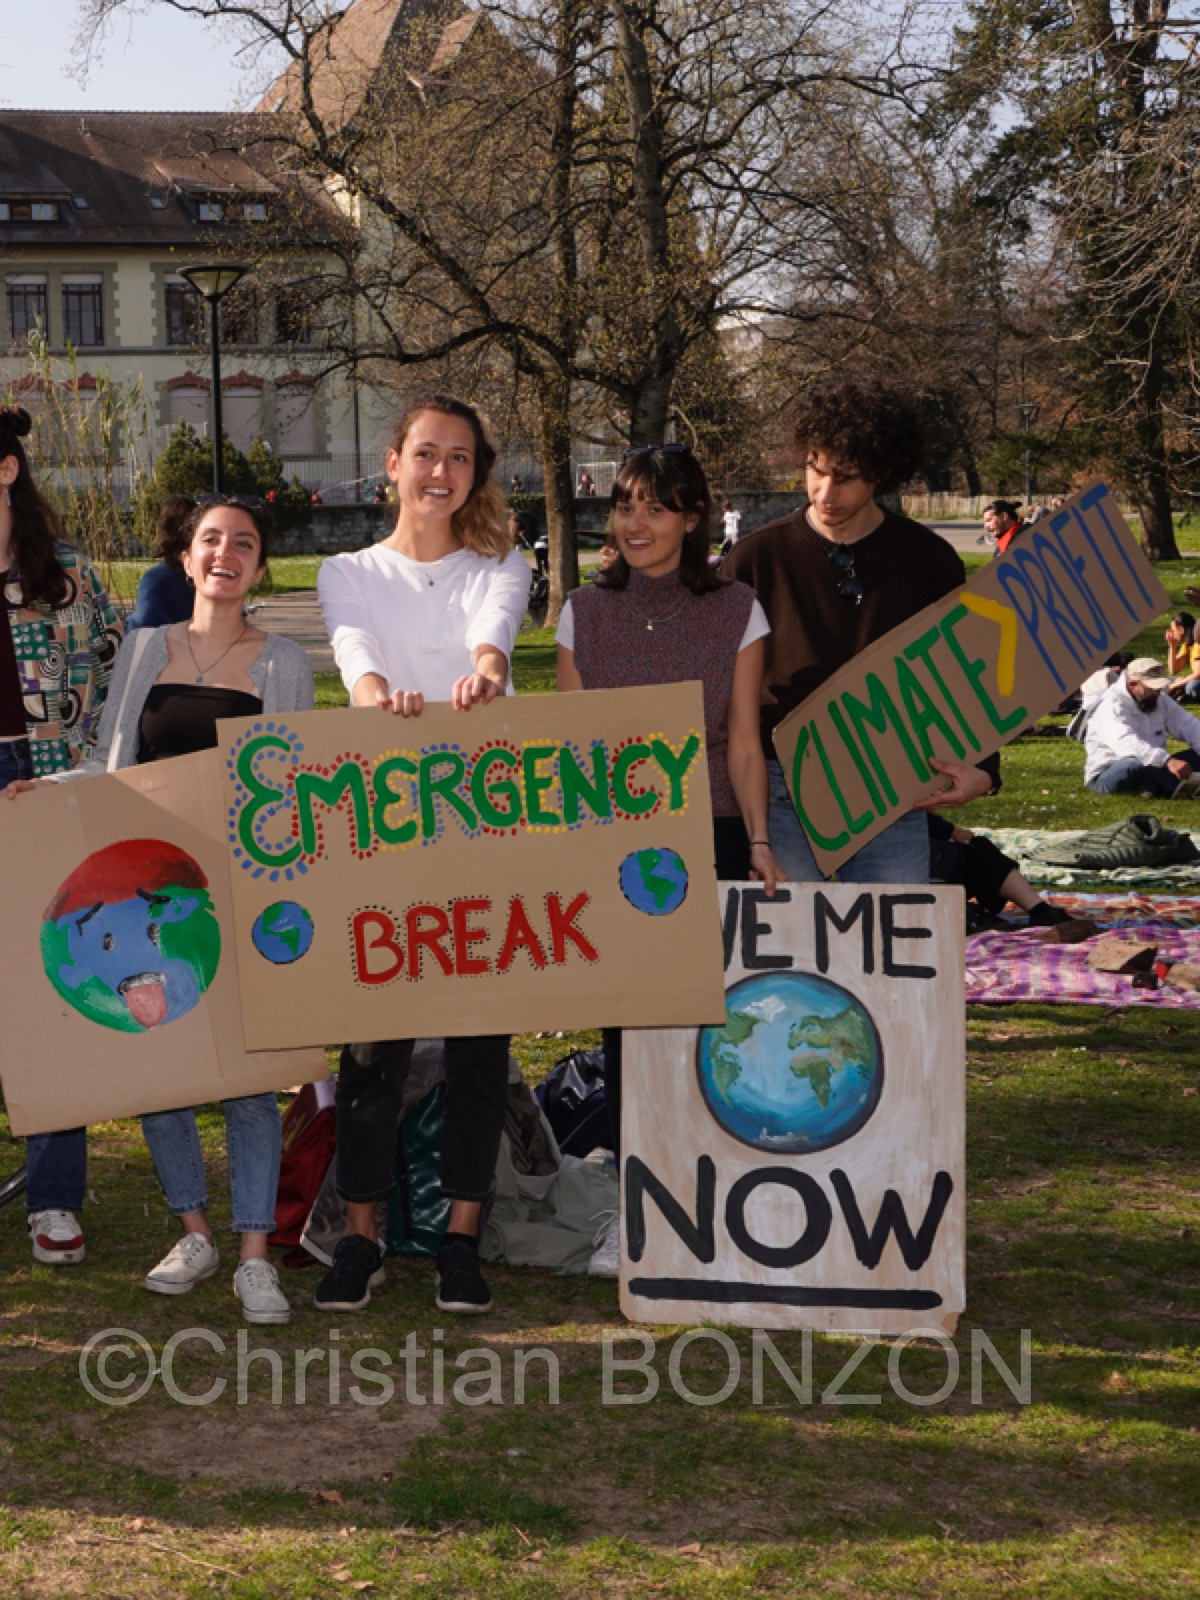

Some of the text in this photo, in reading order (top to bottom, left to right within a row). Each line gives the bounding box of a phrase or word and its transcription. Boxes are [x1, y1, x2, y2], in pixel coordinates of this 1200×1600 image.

[792, 604, 1028, 852] CLIMATE
[996, 483, 1155, 693] PROFIT
[236, 734, 701, 868] EMERGENCY
[353, 892, 599, 985] BREAK
[813, 890, 937, 979] ME
[625, 1154, 954, 1272] NOW
